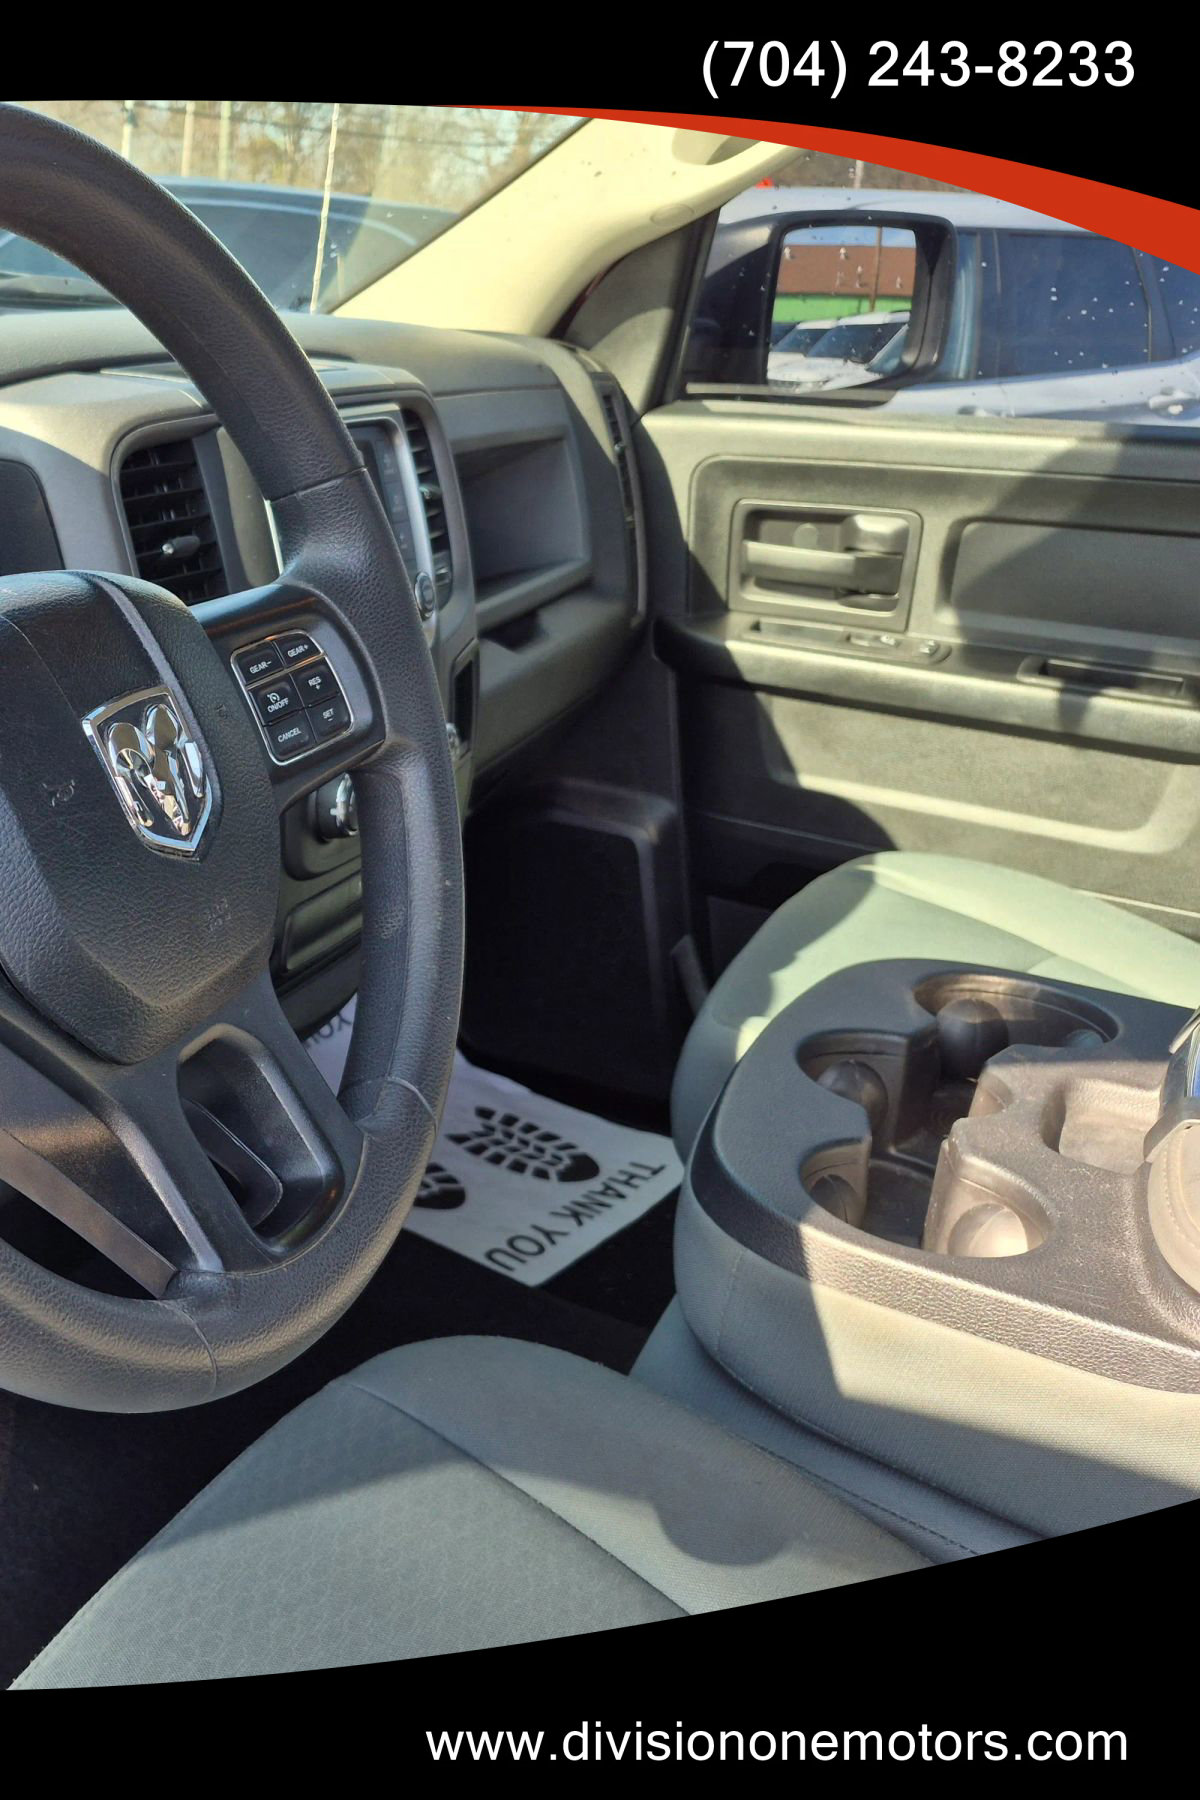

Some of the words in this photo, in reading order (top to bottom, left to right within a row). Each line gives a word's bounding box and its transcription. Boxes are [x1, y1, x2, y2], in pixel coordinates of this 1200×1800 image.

[287, 644, 309, 658] GEAR+
[308, 675, 322, 687] RES
[267, 697, 289, 713] ON/OFF
[322, 707, 334, 719] SET
[277, 727, 302, 743] CANCEL
[550, 1161, 667, 1228] THANK
[484, 1222, 571, 1273] YOU
